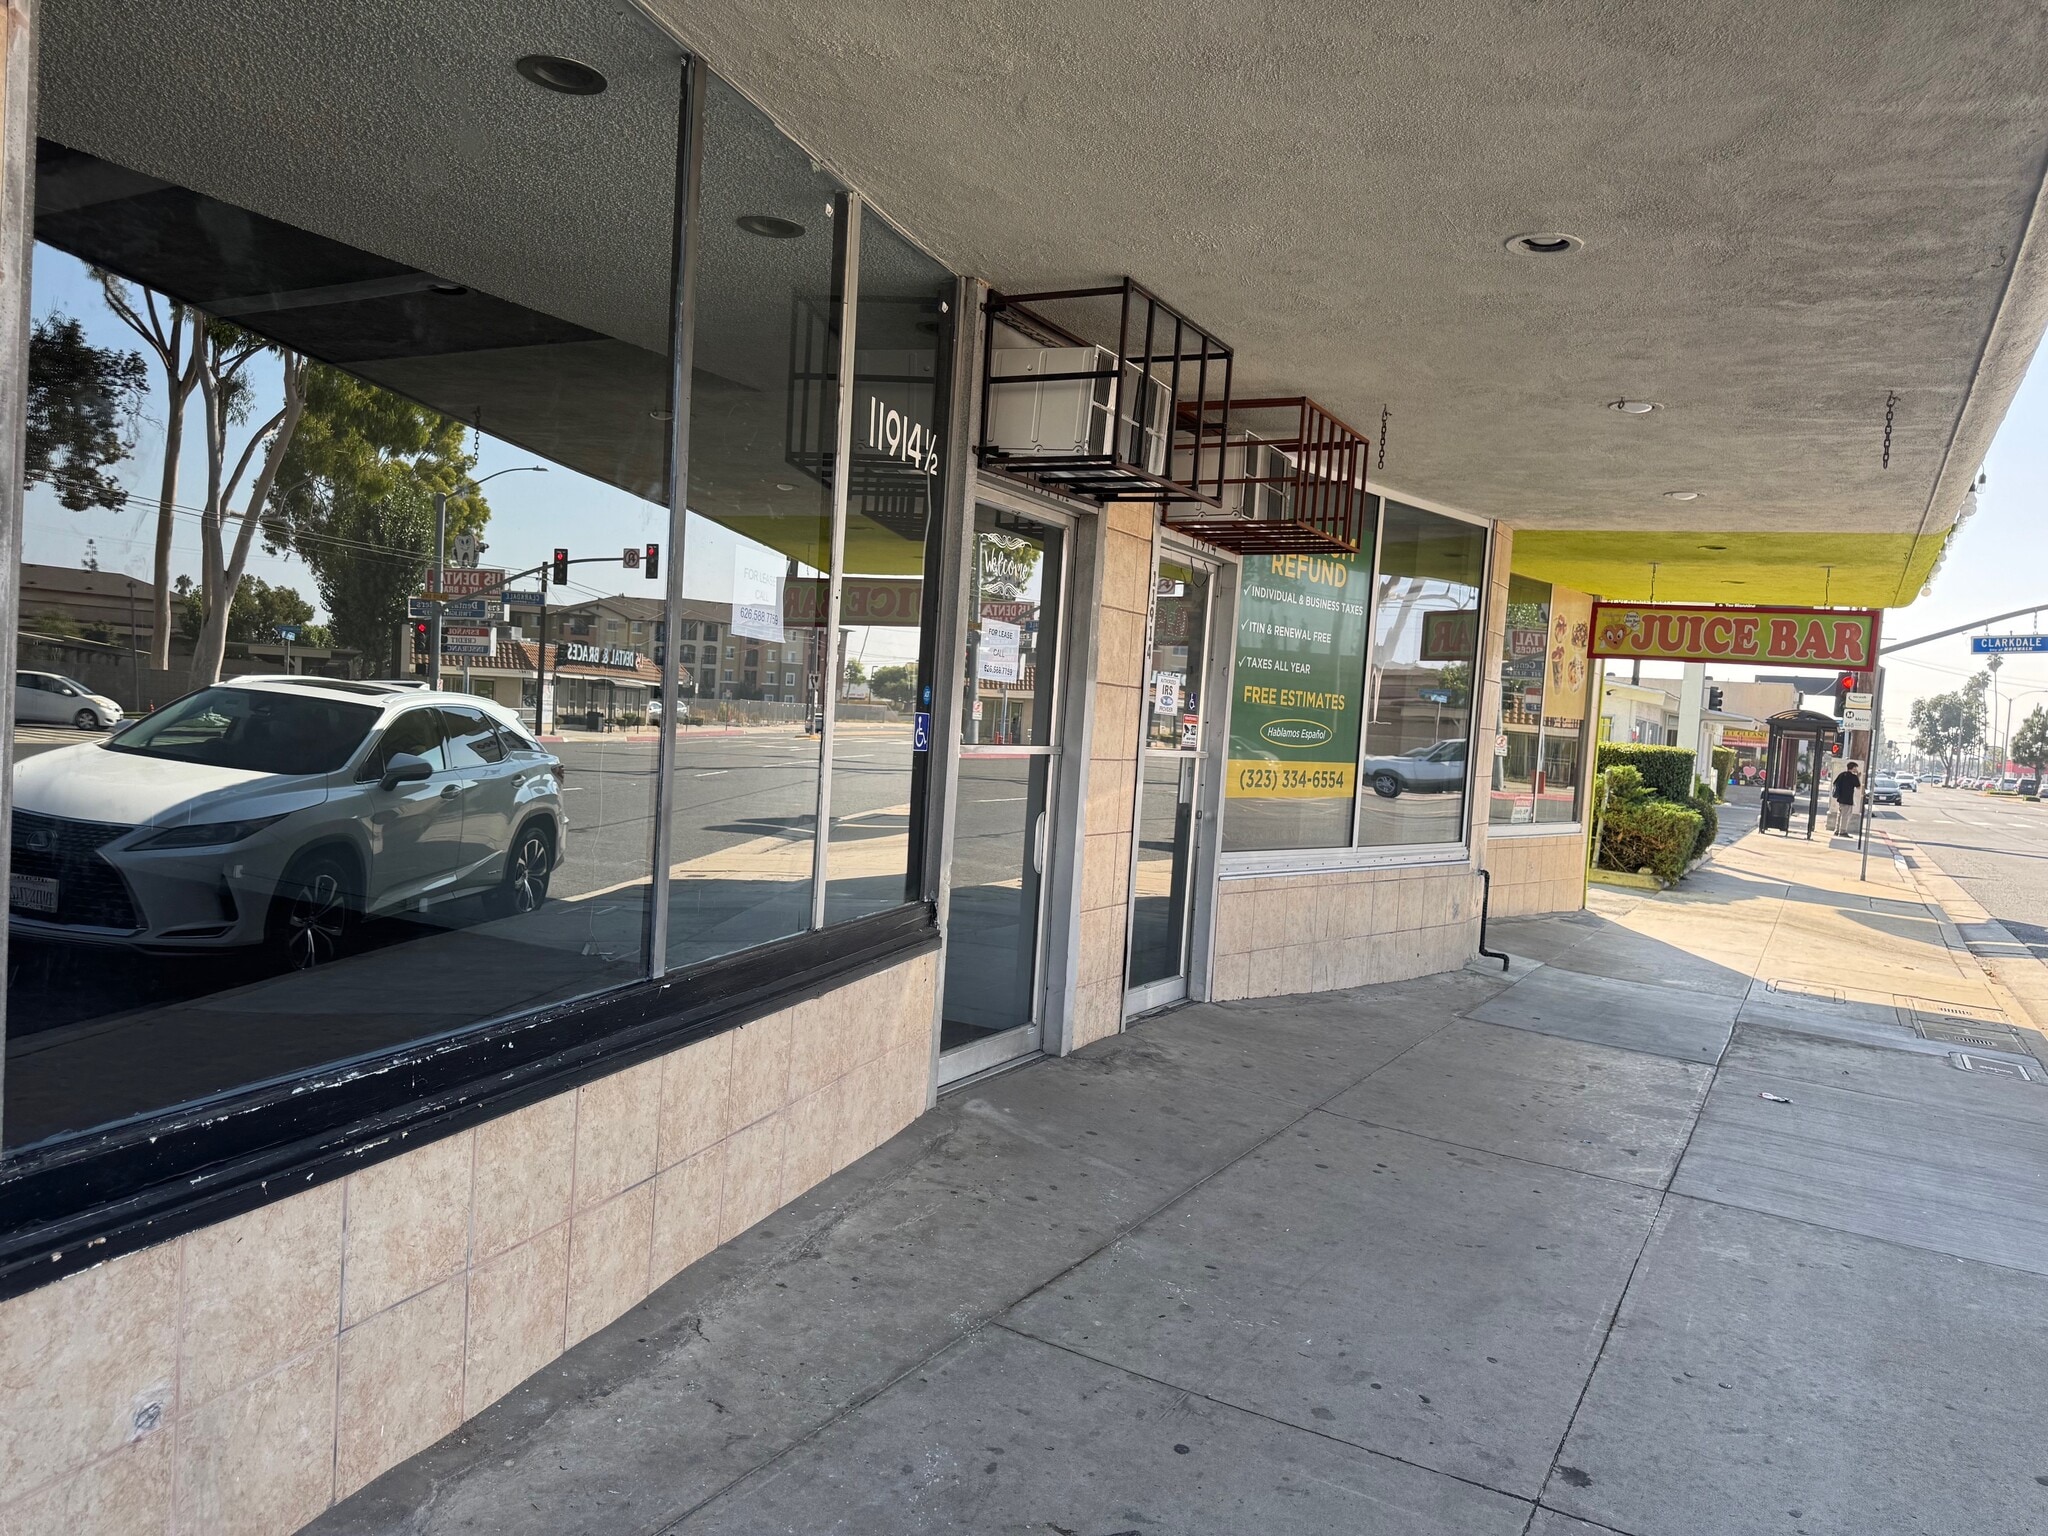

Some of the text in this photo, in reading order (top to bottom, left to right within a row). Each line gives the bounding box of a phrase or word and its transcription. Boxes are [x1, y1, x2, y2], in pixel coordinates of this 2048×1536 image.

[870, 396, 922, 469] 11914
[744, 567, 759, 581] FOR
[984, 548, 1031, 582] Welcome
[1271, 553, 1347, 588] REFUND
[1251, 585, 1364, 616] INDIVIDUAL & BUSINESS TAXES
[988, 628, 999, 638] FOR
[1249, 622, 1332, 644] ITIN & RENEWAL FREE
[1630, 613, 1865, 662] JUICE BAR
[1981, 637, 2043, 648] CLARKDALE
[993, 649, 1005, 658] CALL
[1247, 657, 1311, 675] TAXES ALL YEAR
[1162, 684, 1175, 698] IRS
[1244, 685, 1346, 711] FREE ESTIMATES
[1267, 726, 1327, 741] Hablamos Español
[1240, 769, 1344, 791] (323) 334-6554
